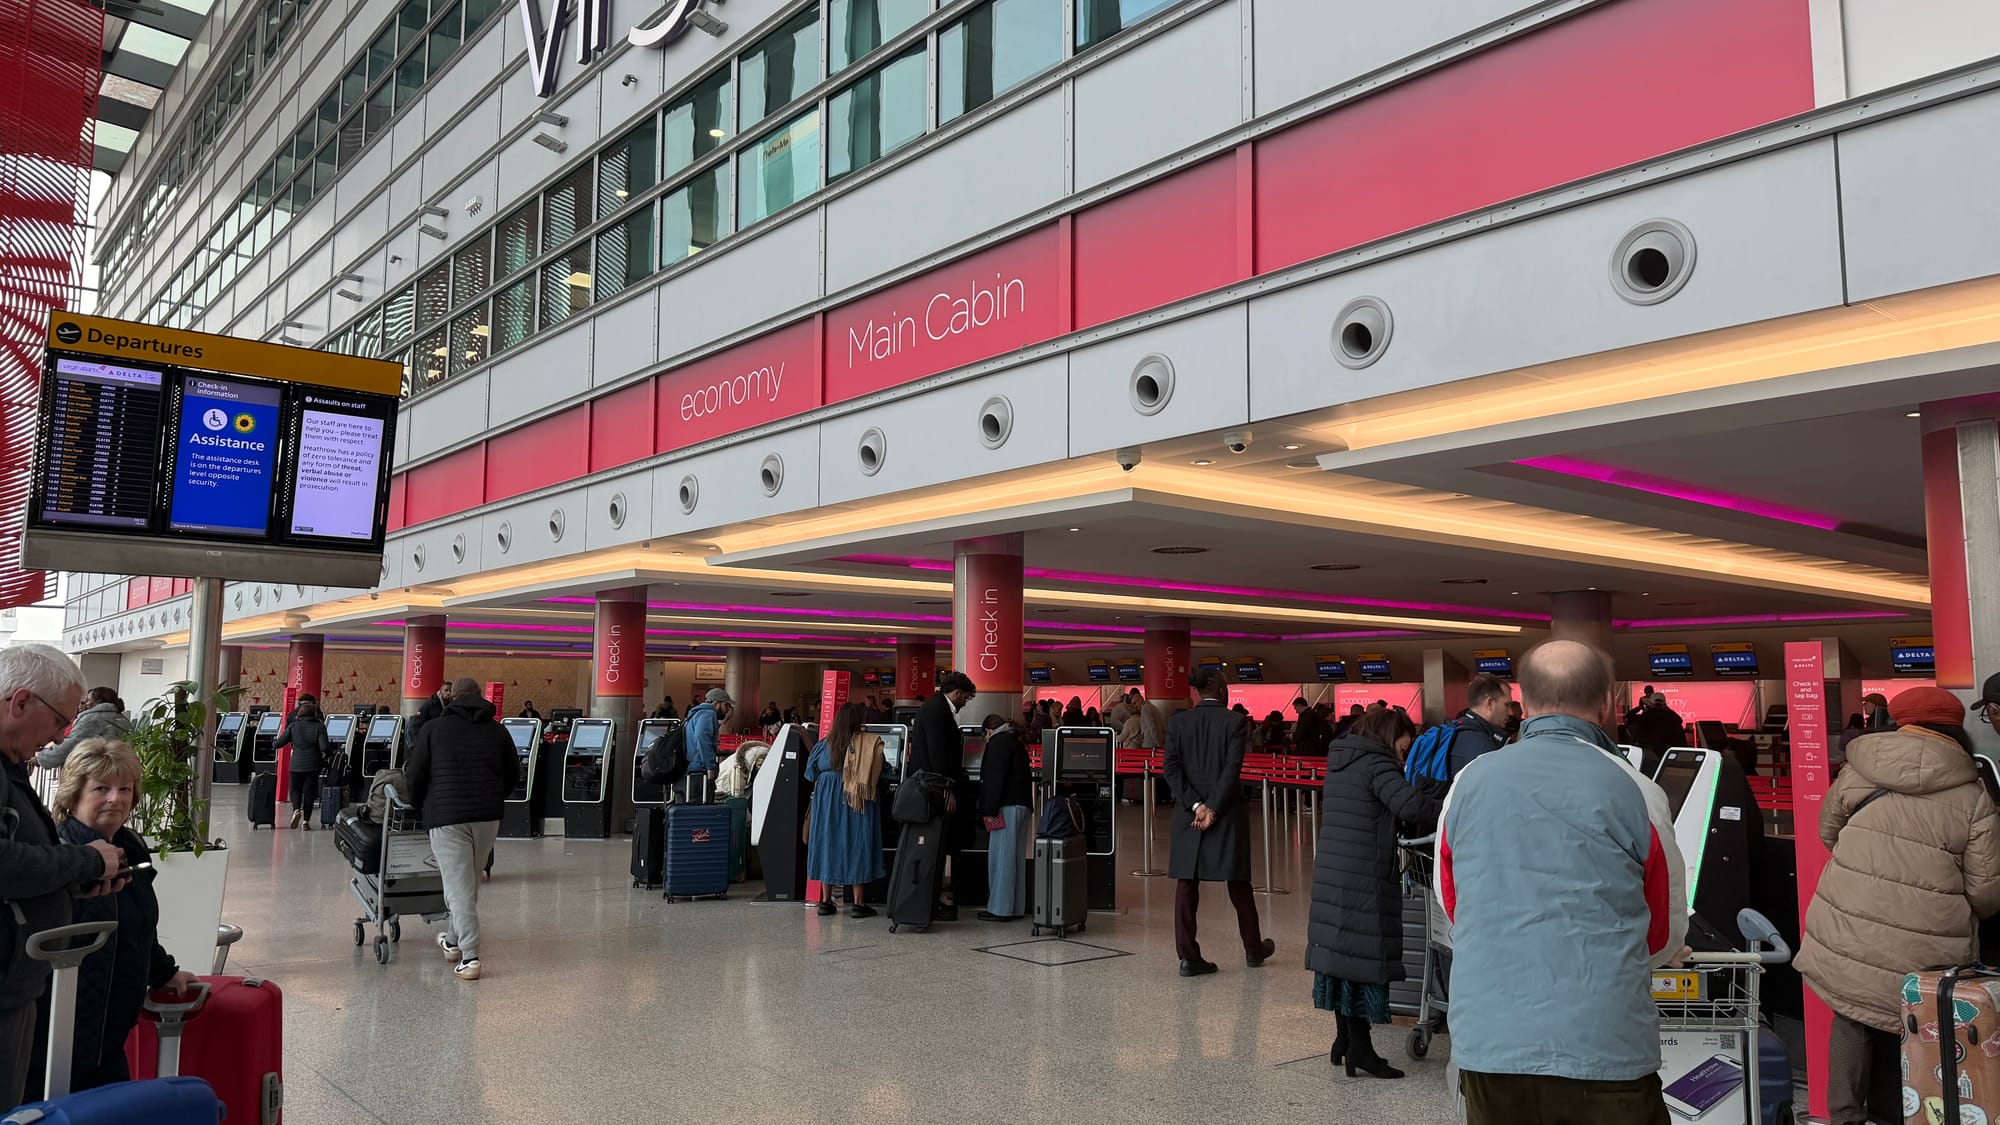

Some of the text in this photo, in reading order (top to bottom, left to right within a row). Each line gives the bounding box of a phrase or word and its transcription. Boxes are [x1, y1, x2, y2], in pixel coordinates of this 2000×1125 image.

[849, 272, 1025, 369] Main Cabin
[88, 328, 203, 358] Departures
[197, 382, 228, 391] Check-in
[681, 361, 784, 421] economy
[197, 388, 238, 399] information
[313, 397, 340, 406] Assaults
[320, 419, 335, 427] staff
[348, 422, 363, 430] here
[324, 434, 338, 442] with
[340, 436, 365, 445] respect.
[341, 430, 361, 438] please
[189, 433, 264, 451] Assistance
[303, 445, 336, 454] Heathrow
[338, 447, 349, 455] has
[356, 450, 374, 459] policy
[206, 455, 242, 464] assistance
[243, 458, 260, 466] desk
[327, 454, 358, 463] tolerance
[358, 457, 371, 465] and
[222, 464, 261, 475] departures
[301, 467, 322, 475] verbal
[323, 469, 343, 477] abuse
[208, 472, 240, 480] opposite
[300, 475, 328, 483] violence
[342, 479, 360, 487] result
[188, 478, 219, 488] security.
[299, 483, 338, 492] prosecution
[980, 588, 998, 672] Check in
[606, 625, 621, 683] Check in
[411, 643, 423, 689] Check in
[1165, 646, 1174, 689] Check in
[293, 655, 303, 692] Check in
[911, 665, 919, 691] Check
